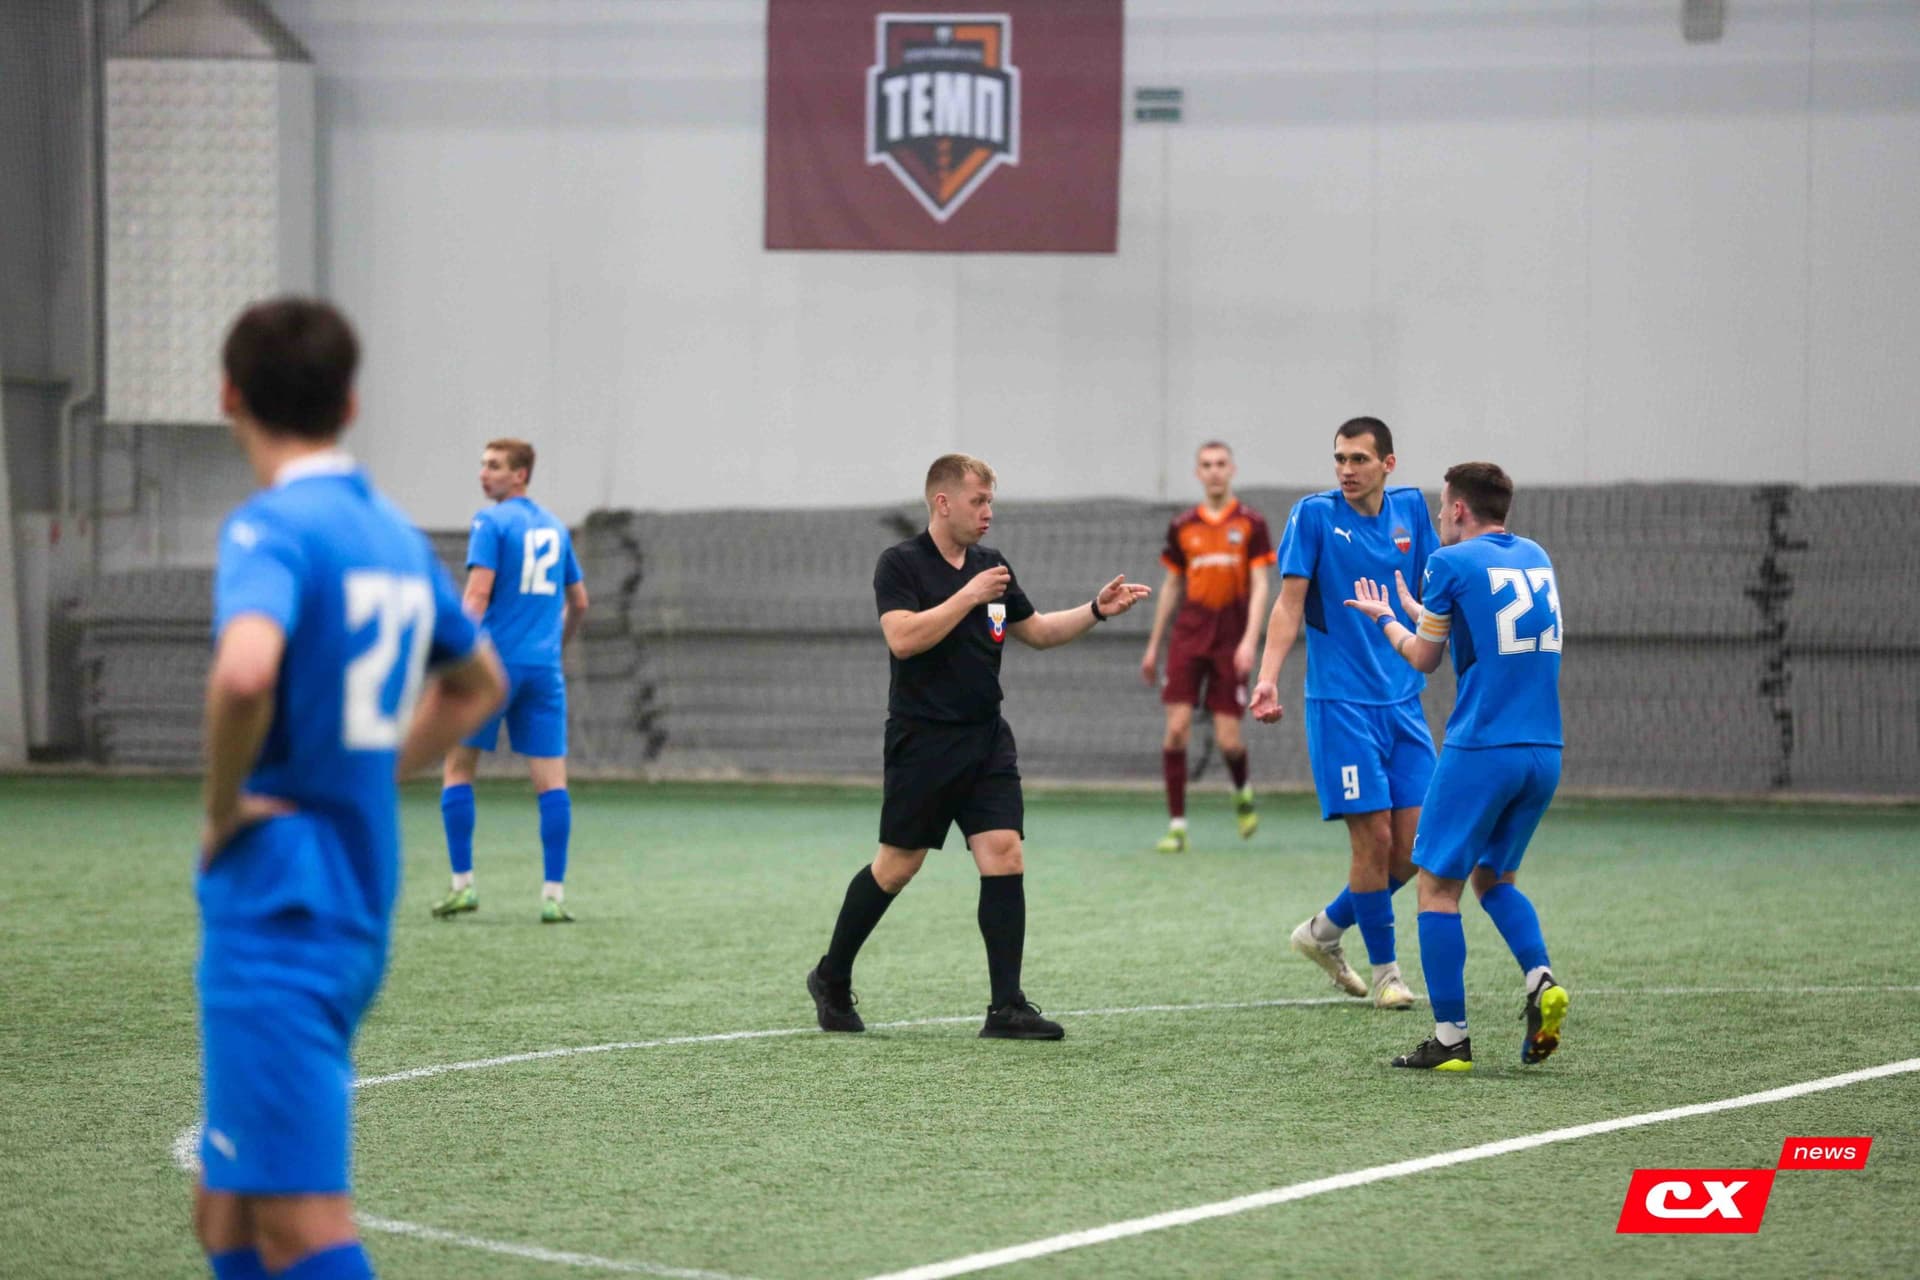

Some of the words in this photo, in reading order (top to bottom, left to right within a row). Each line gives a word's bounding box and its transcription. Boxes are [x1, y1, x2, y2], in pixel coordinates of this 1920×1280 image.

[882, 72, 1004, 143] ТЕМП
[520, 528, 560, 596] 12
[1487, 567, 1563, 655] 23
[1341, 765, 1360, 800] 9
